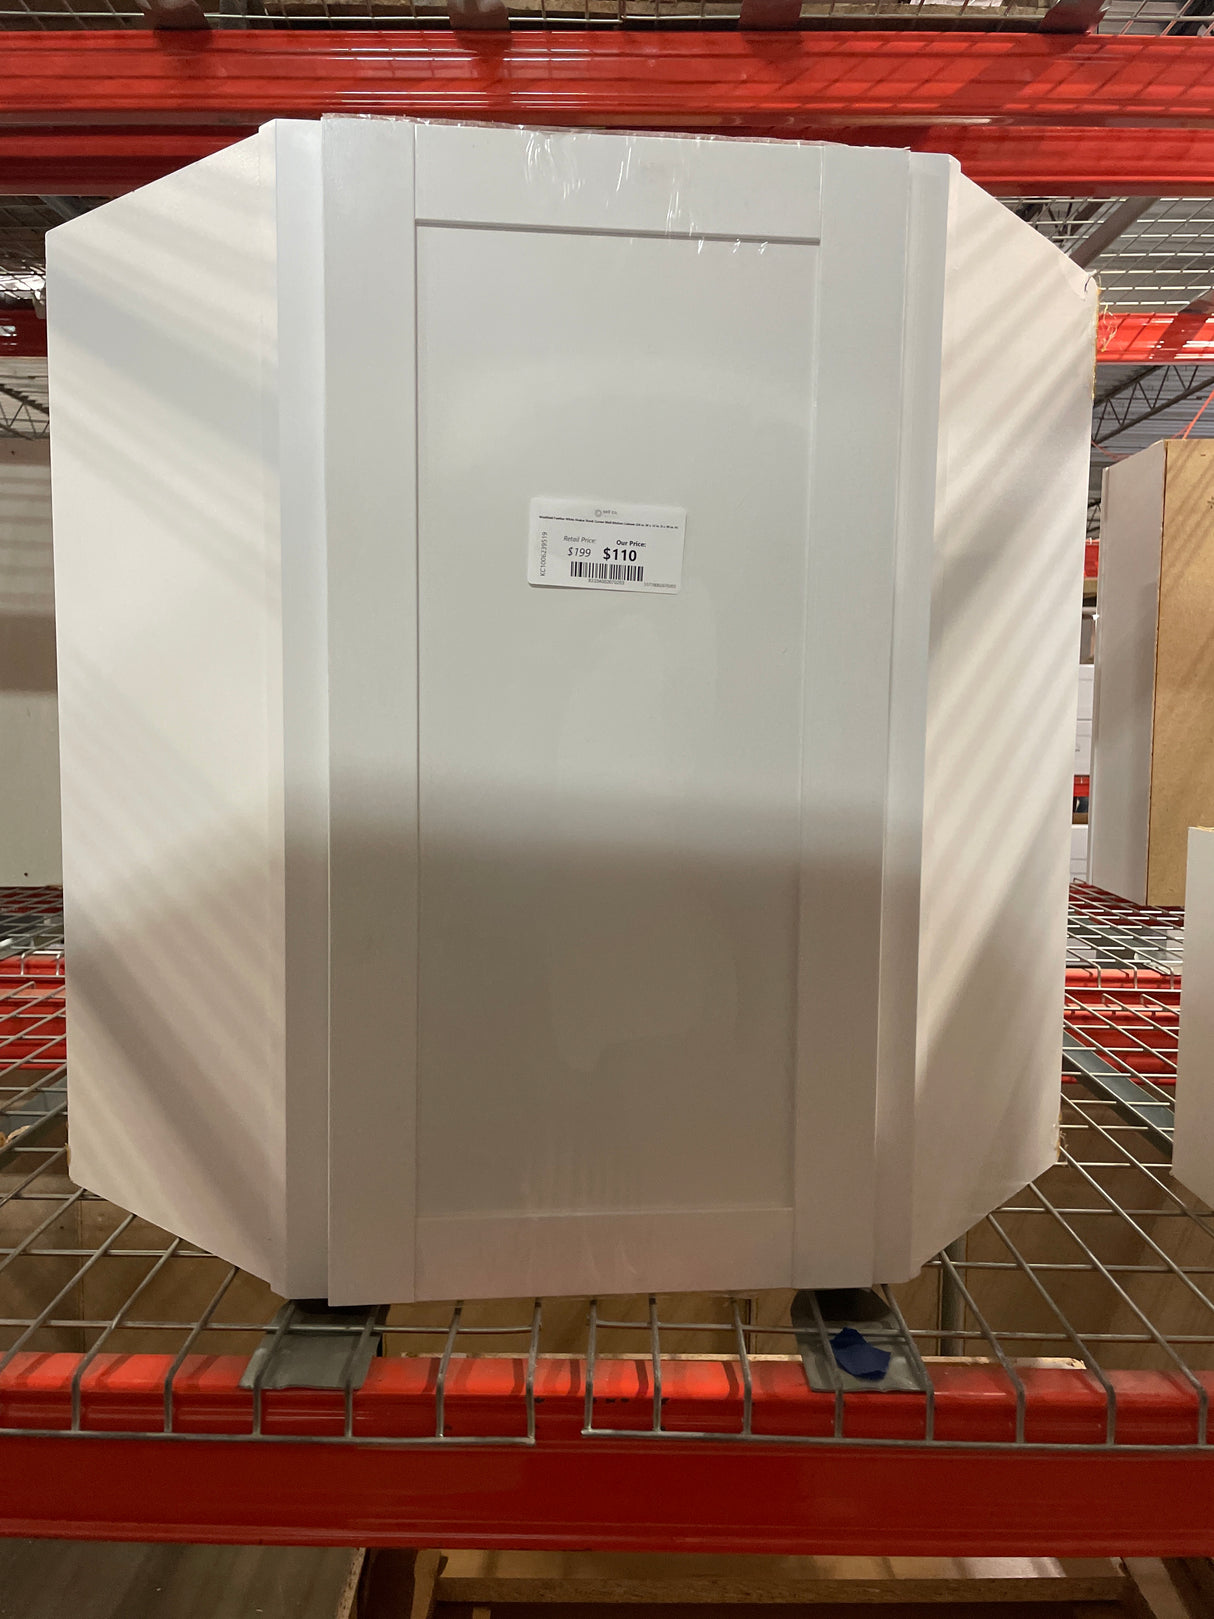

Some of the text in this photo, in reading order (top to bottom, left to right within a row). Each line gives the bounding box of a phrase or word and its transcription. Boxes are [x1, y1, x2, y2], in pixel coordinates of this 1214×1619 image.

[563, 535, 580, 543] Retail
[629, 540, 647, 548] Price:
[567, 546, 592, 558] $199
[602, 546, 637, 562] $110
